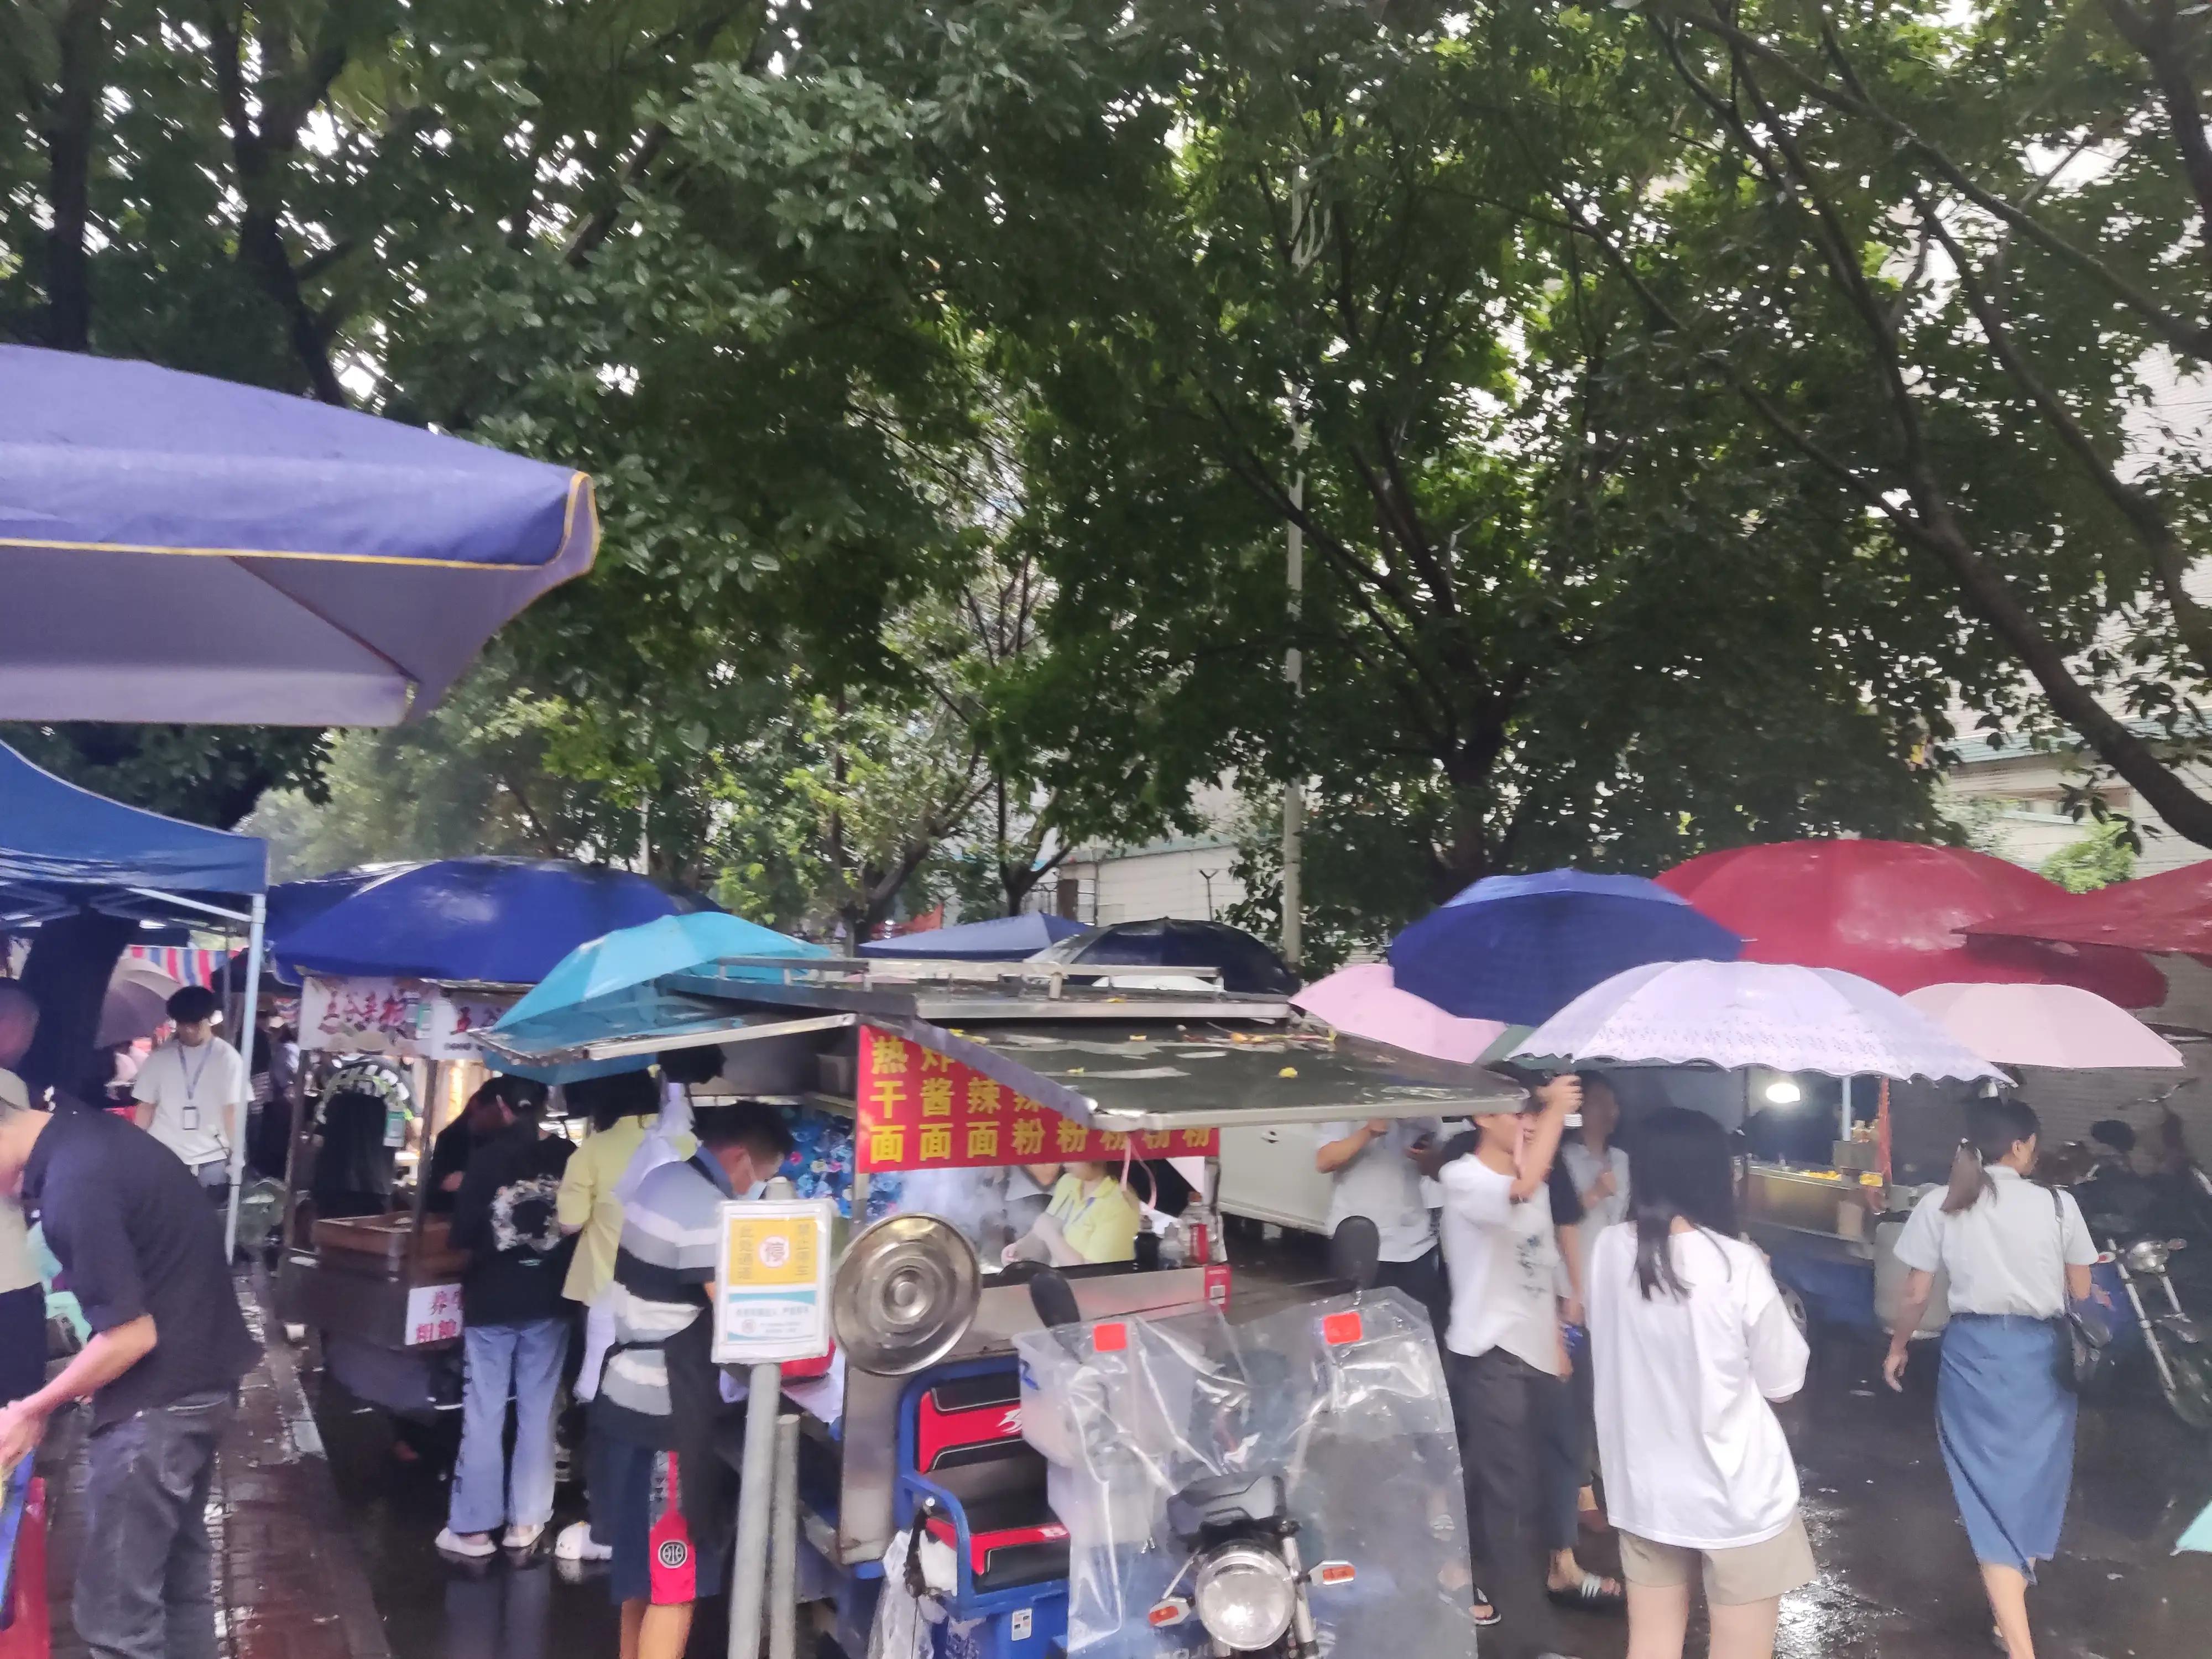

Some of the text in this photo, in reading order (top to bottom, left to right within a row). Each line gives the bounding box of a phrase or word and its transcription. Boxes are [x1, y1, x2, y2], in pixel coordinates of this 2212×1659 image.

[869, 1035, 909, 1164] 热干面
[966, 1076, 1001, 1158] 辣面
